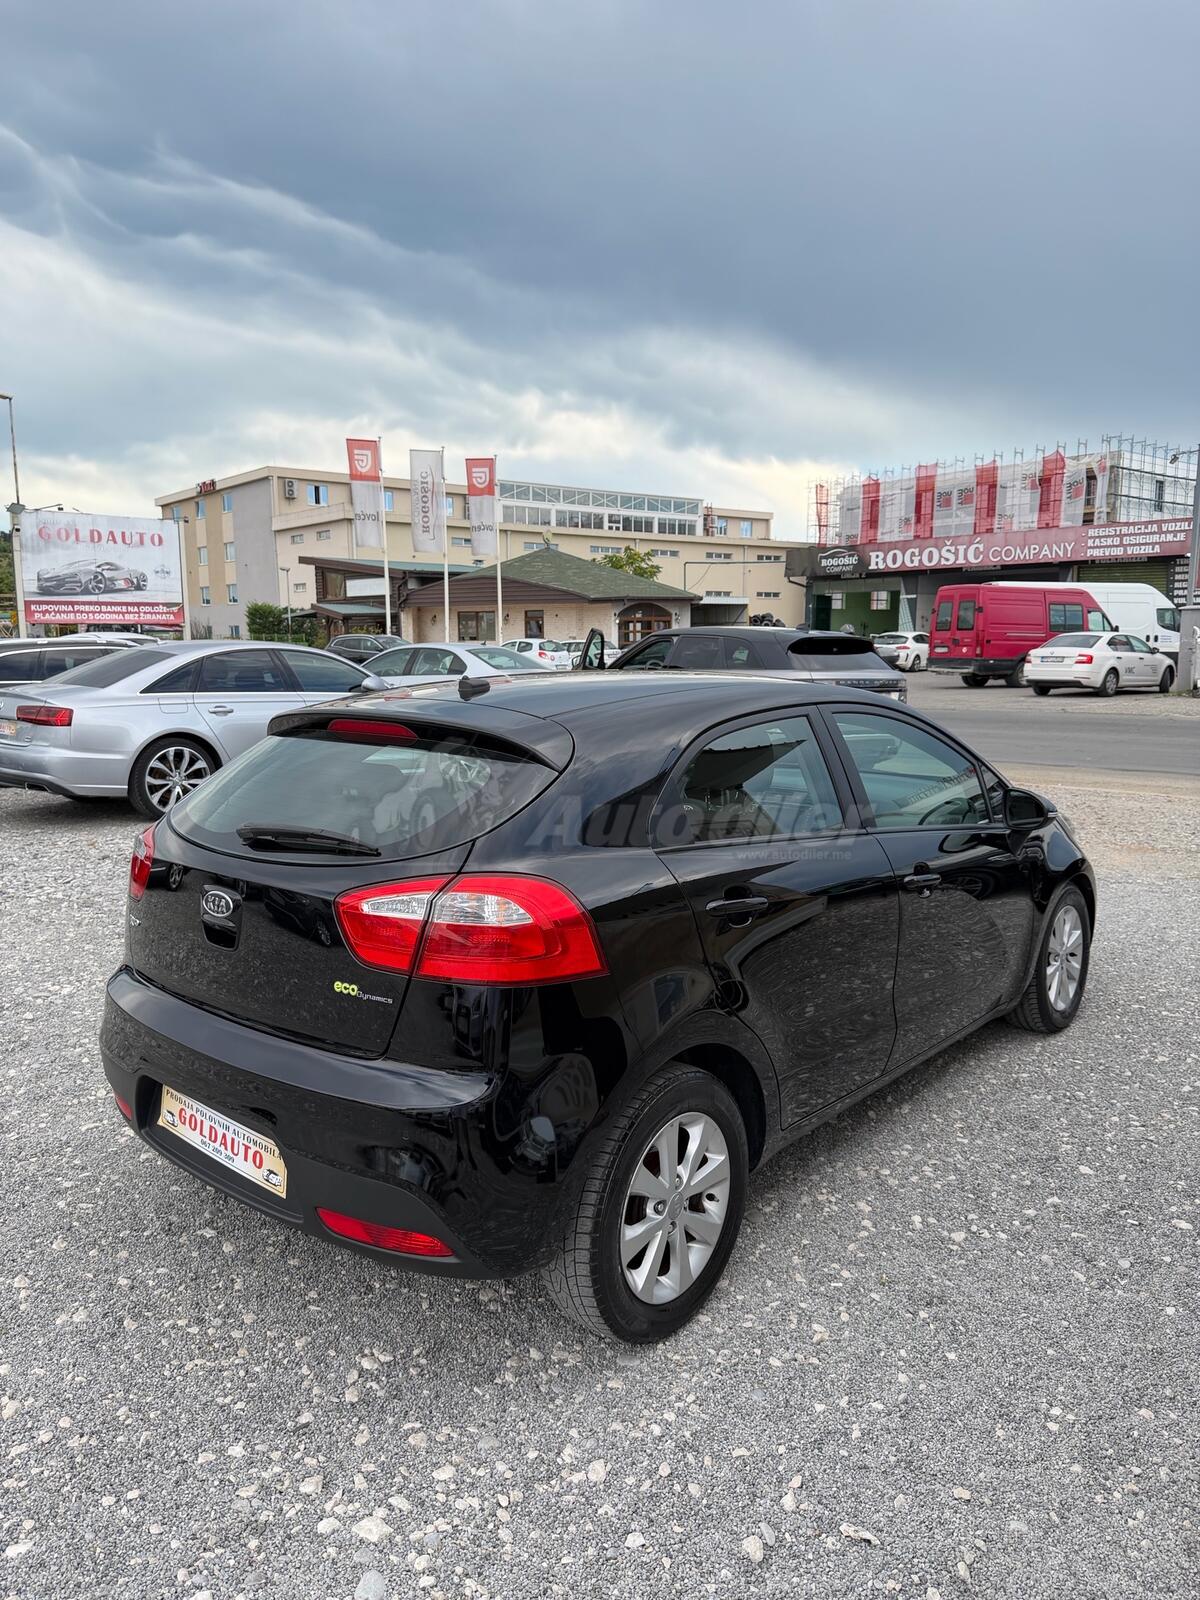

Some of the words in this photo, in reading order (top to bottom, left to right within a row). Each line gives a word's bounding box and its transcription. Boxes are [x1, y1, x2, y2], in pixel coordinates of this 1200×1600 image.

[38, 526, 164, 547] GOLDAUTO
[1088, 524, 1158, 537] REGISTRACIJA
[1087, 537, 1120, 547] KASKO
[1123, 533, 1187, 545] OSIGURANJE
[868, 537, 984, 570] ROGOŠIĆ
[988, 542, 1075, 562] COMPANY
[1087, 547, 1124, 557] PREVOD
[1126, 545, 1160, 554] VOZILA
[825, 565, 854, 573] COMPANY
[94, 612, 123, 620] GODINA
[166, 1089, 194, 1111] PRODAJA
[195, 1107, 230, 1132] POLOVNIH
[178, 1107, 264, 1170] GOLDAUTO
